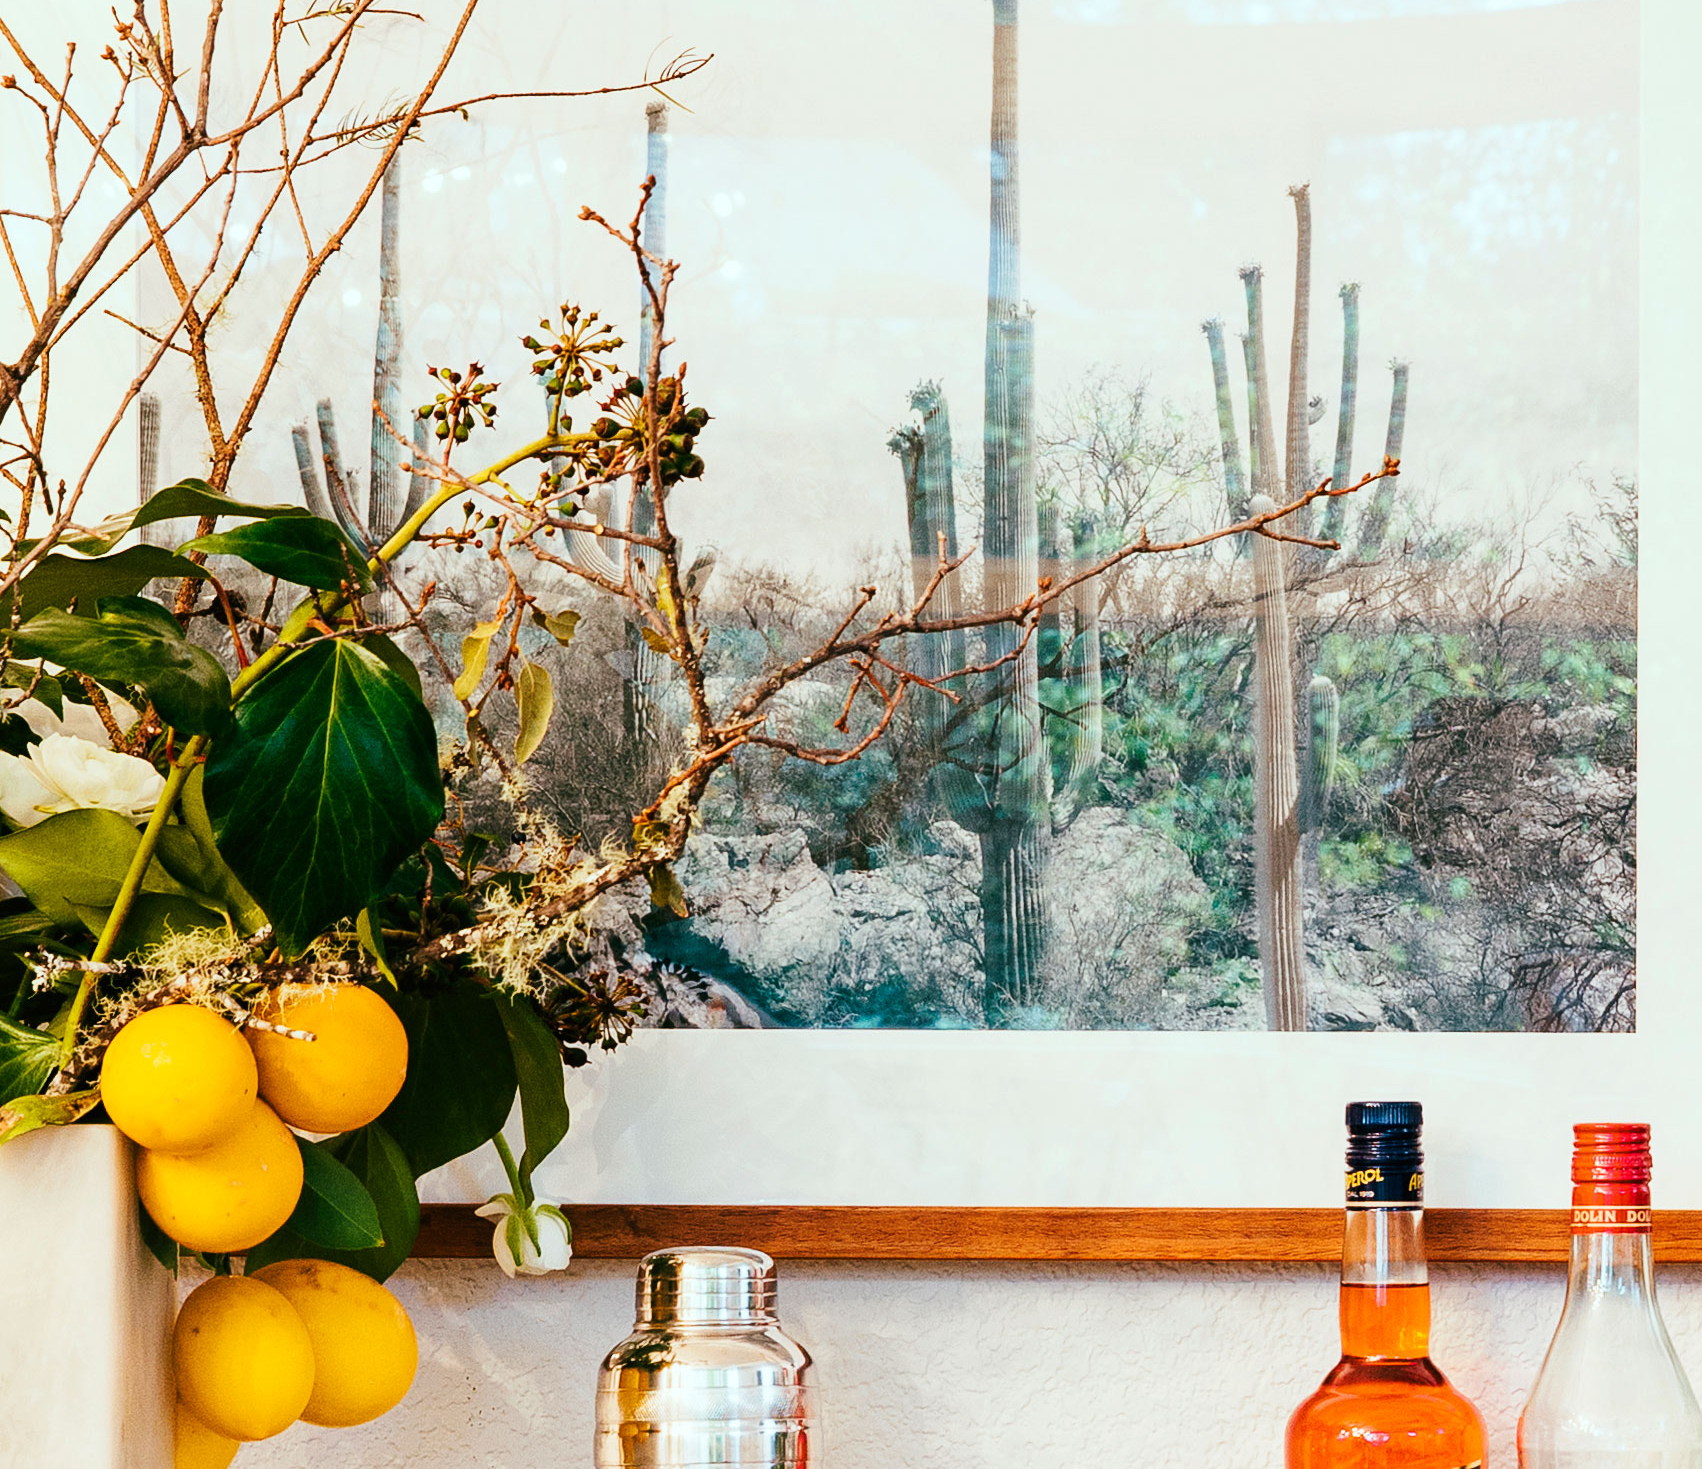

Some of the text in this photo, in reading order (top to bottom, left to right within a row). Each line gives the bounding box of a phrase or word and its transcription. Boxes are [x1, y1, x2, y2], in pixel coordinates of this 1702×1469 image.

[1346, 1168, 1384, 1190] PEROL
[1574, 1210, 1651, 1223] DOLIN DOL
